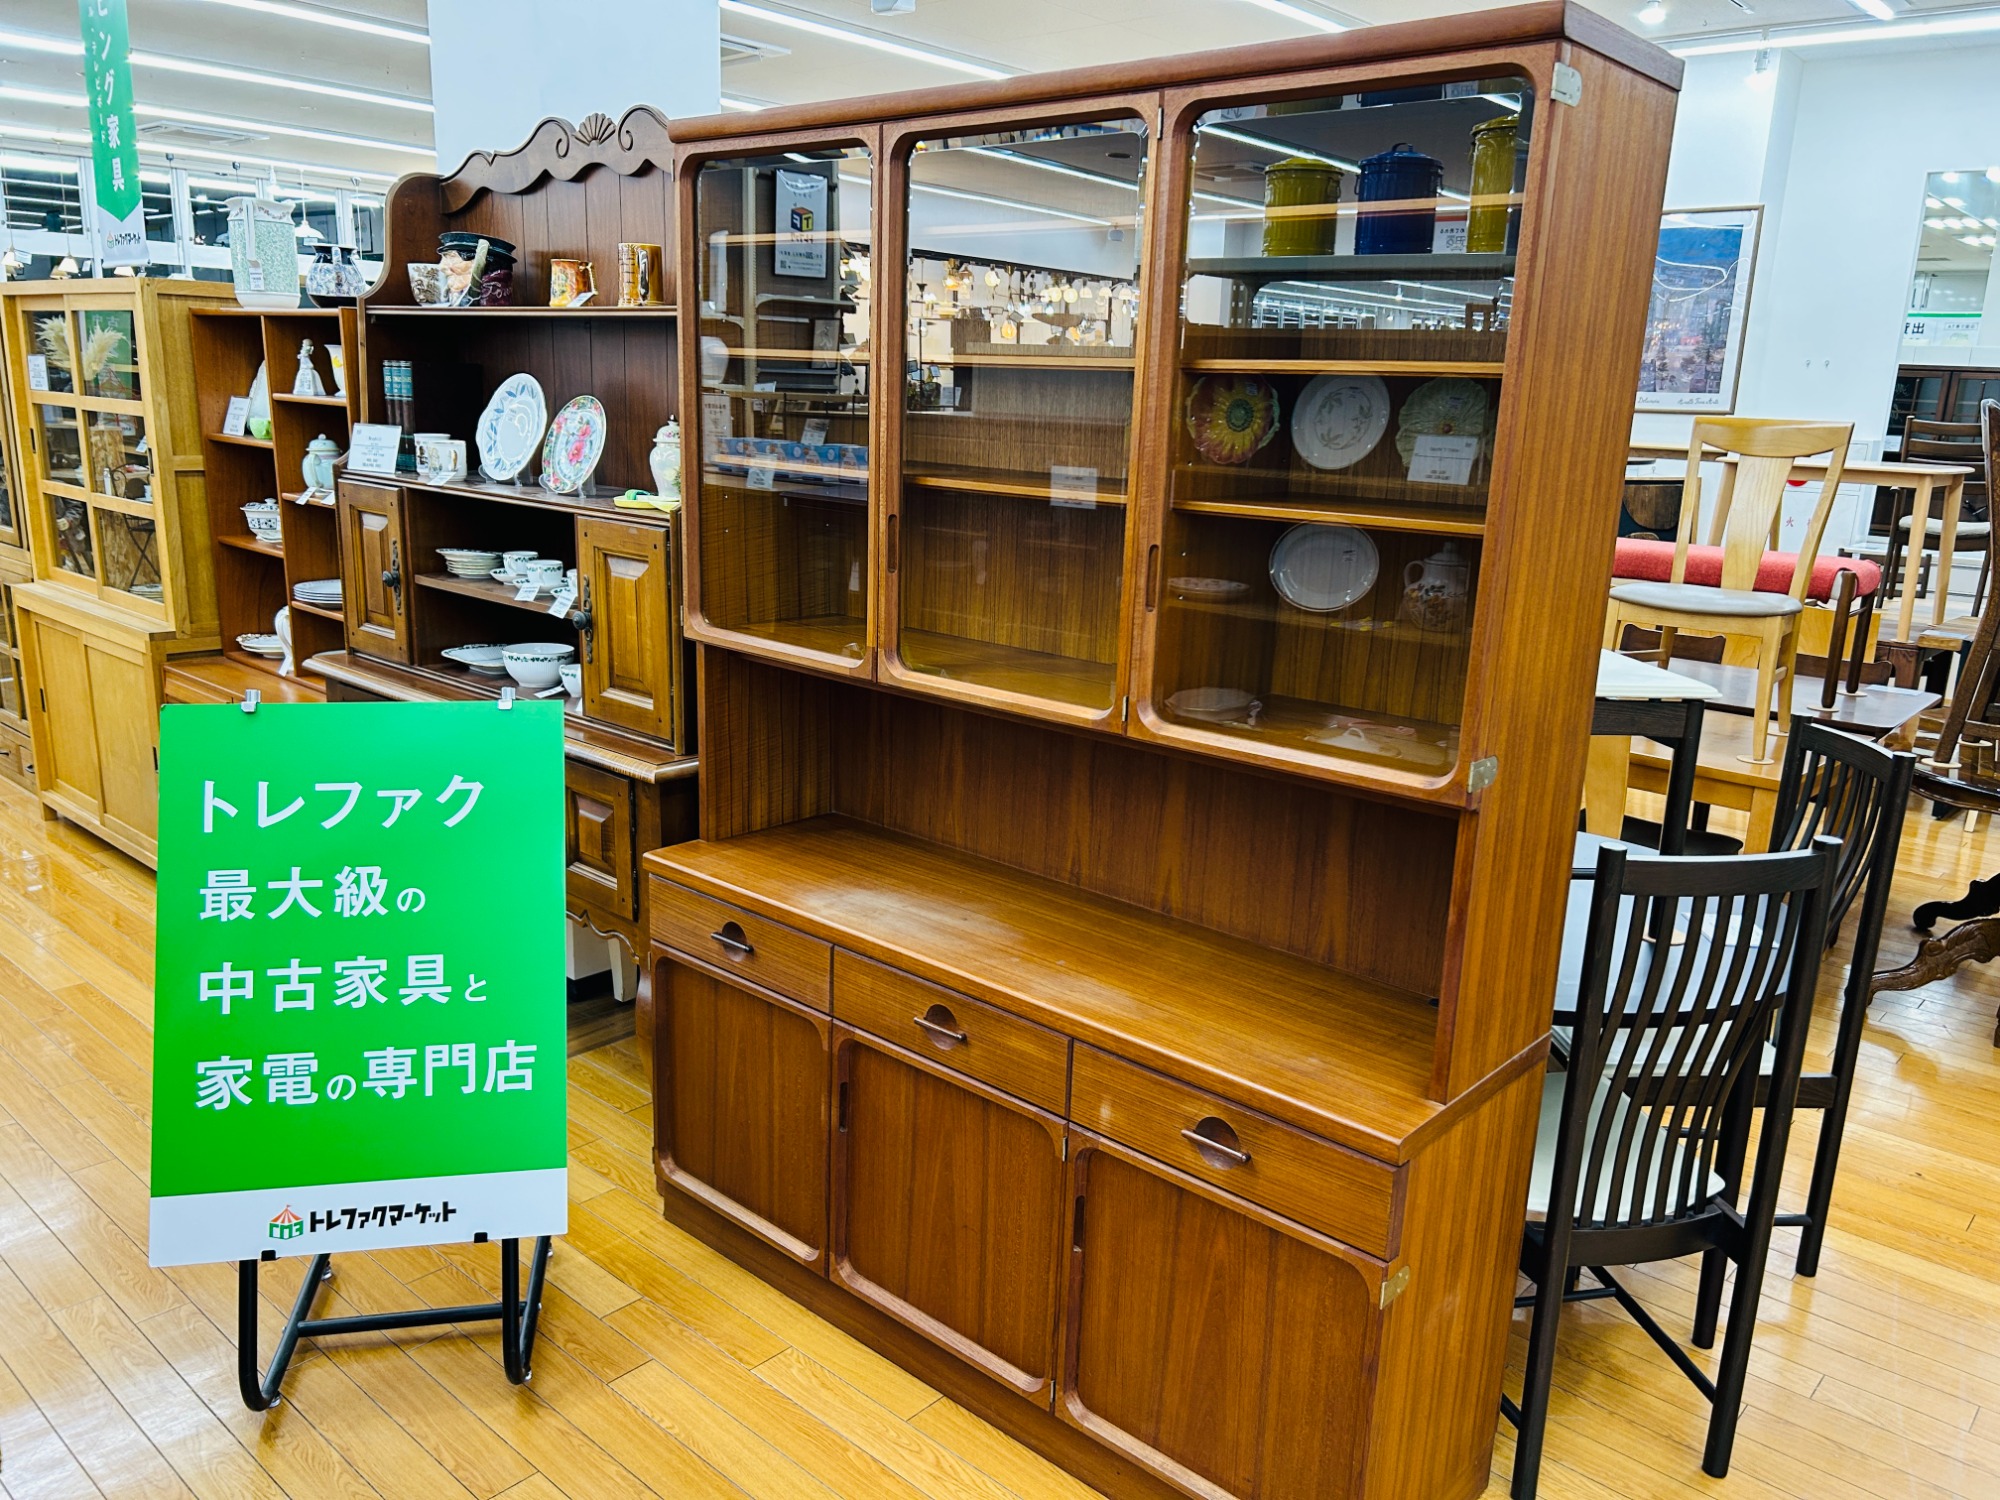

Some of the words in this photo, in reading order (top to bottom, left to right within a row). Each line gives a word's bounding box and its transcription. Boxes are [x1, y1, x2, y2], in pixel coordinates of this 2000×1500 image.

[202, 774, 485, 834] トレファク
[198, 864, 427, 922] 最大級の
[198, 953, 489, 1015] 中古家具と
[194, 1039, 538, 1110] 家電の専門店
[309, 1201, 458, 1233] トレファクマーケット
